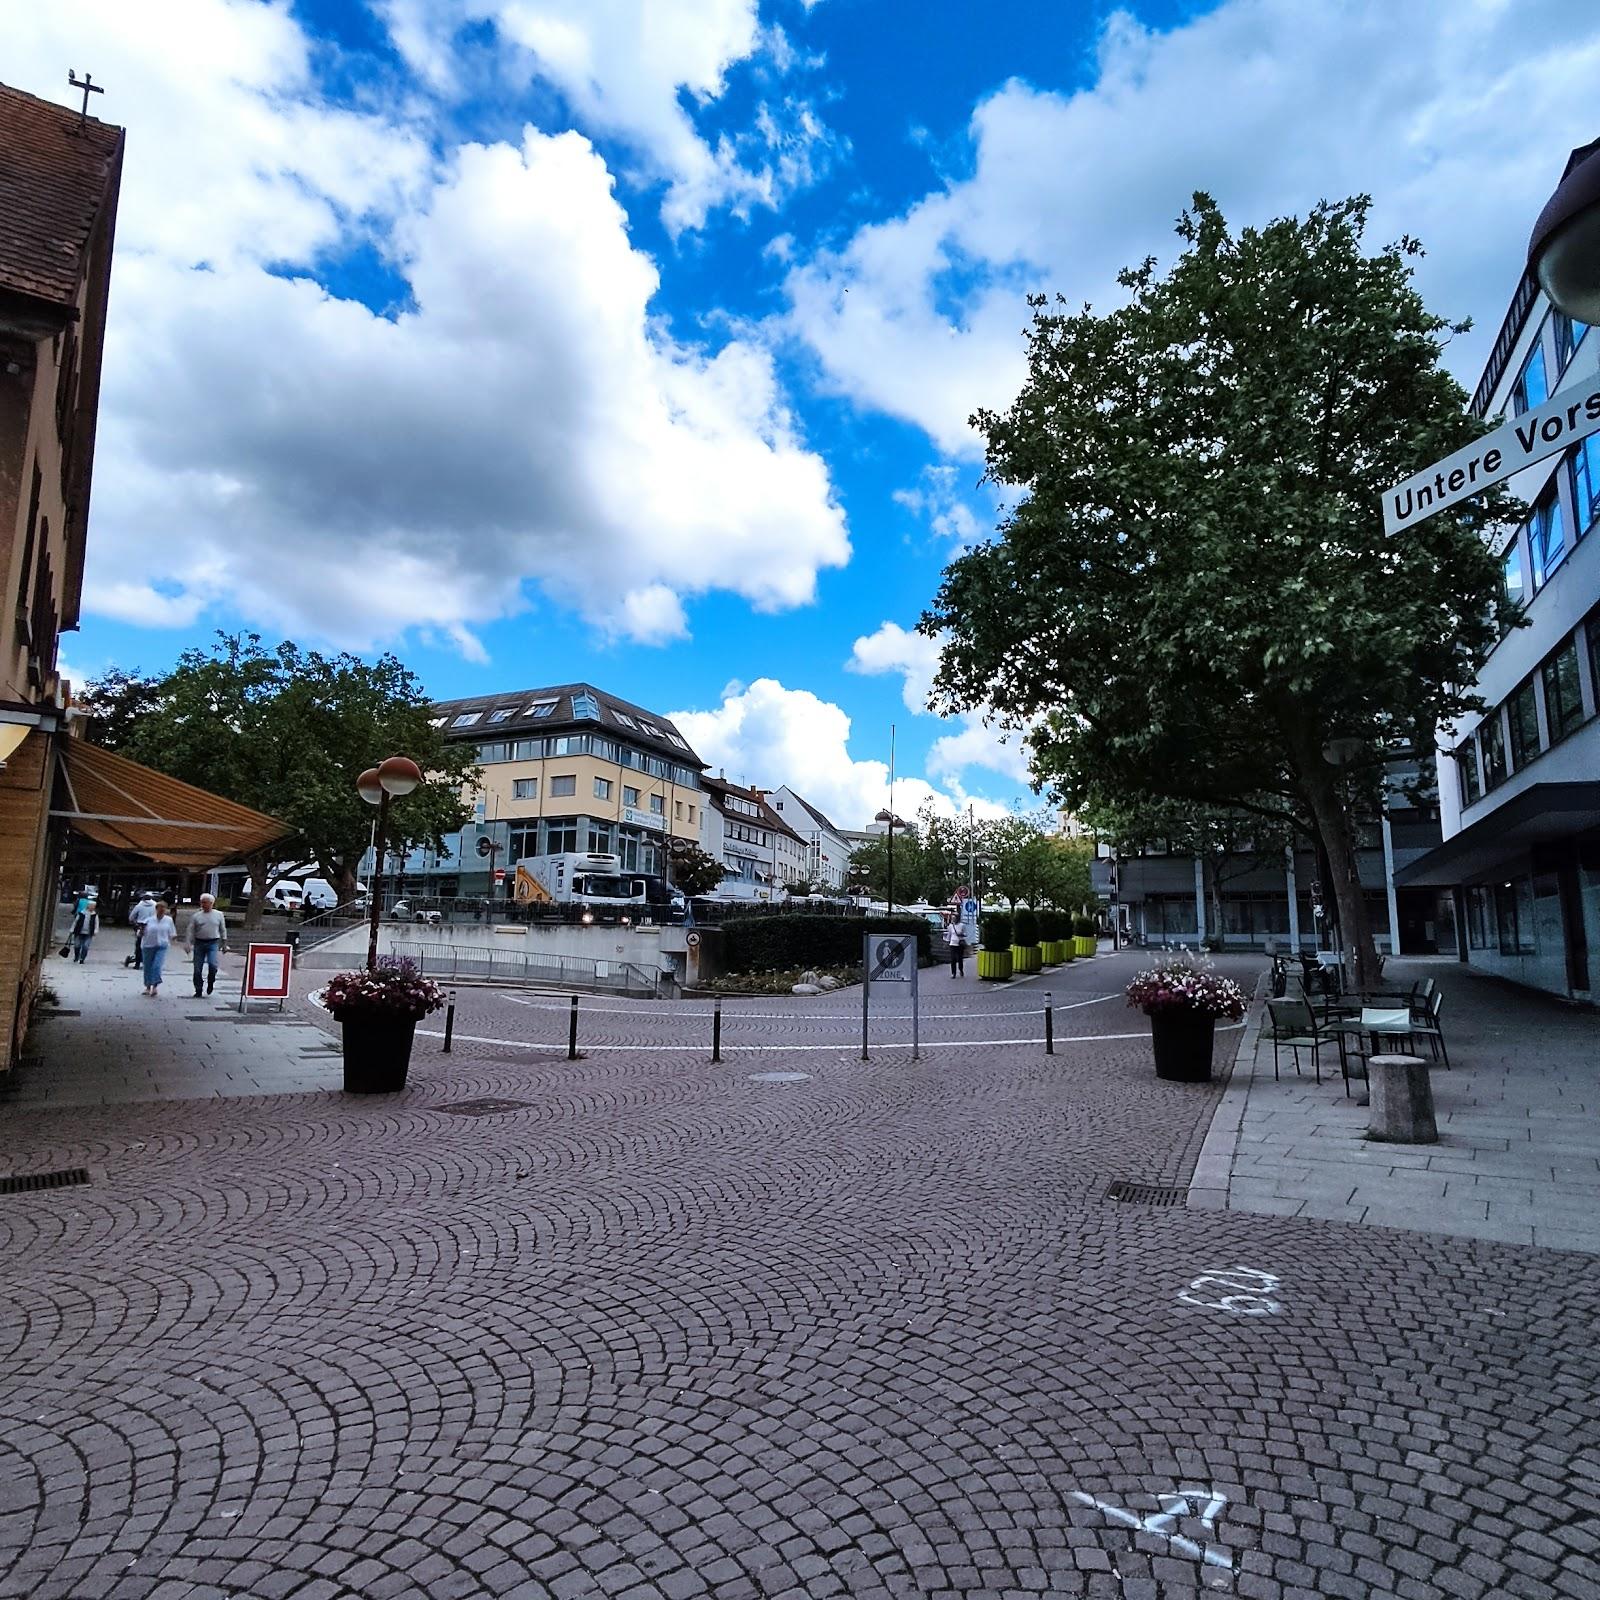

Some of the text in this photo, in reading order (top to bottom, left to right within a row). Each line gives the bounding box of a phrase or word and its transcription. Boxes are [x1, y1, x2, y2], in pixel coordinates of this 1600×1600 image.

[1394, 392, 1600, 520] Untere Vors
[880, 970, 902, 979] ZONE
